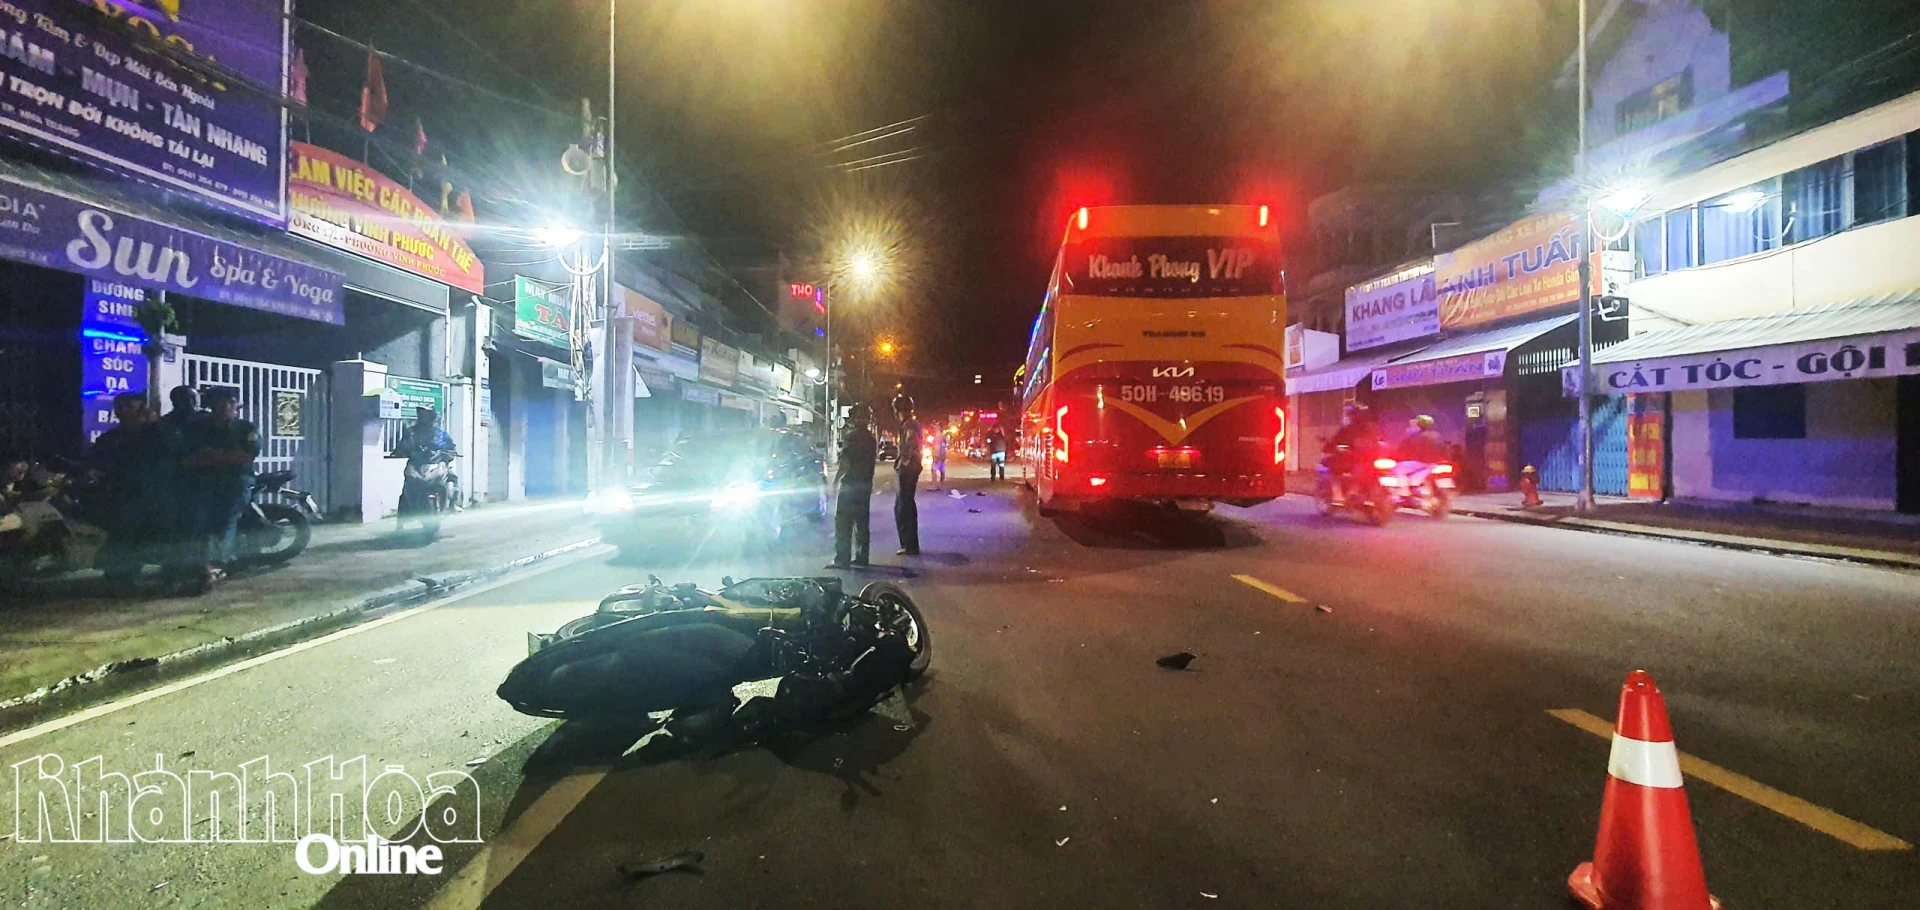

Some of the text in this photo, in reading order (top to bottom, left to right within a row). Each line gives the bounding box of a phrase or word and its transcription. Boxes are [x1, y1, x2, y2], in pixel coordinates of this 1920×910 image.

[10, 74, 64, 110] TRỌN
[105, 113, 165, 149] KHÔNG
[167, 139, 190, 160] TÁI
[191, 150, 215, 169] LẠI
[81, 65, 139, 113] MỤN
[207, 122, 268, 167] NHANG
[335, 165, 375, 202] VIỆC
[380, 185, 411, 220] CÁC
[66, 209, 198, 289] Sun
[210, 254, 256, 287] Spa
[261, 267, 279, 289] &
[284, 274, 335, 305] Yoga
[392, 230, 434, 261] PHƯỚC
[1148, 253, 1200, 283] Phong
[1207, 248, 1254, 279] VIP
[1543, 272, 1564, 289] Honda
[98, 300, 138, 319] SINH
[1352, 291, 1406, 322] KHANG
[102, 355, 134, 373] SÓC
[1608, 362, 1670, 389] CẮT
[1681, 357, 1762, 384] TÓC
[1796, 345, 1886, 378] GỘI
[105, 376, 130, 390] DA
